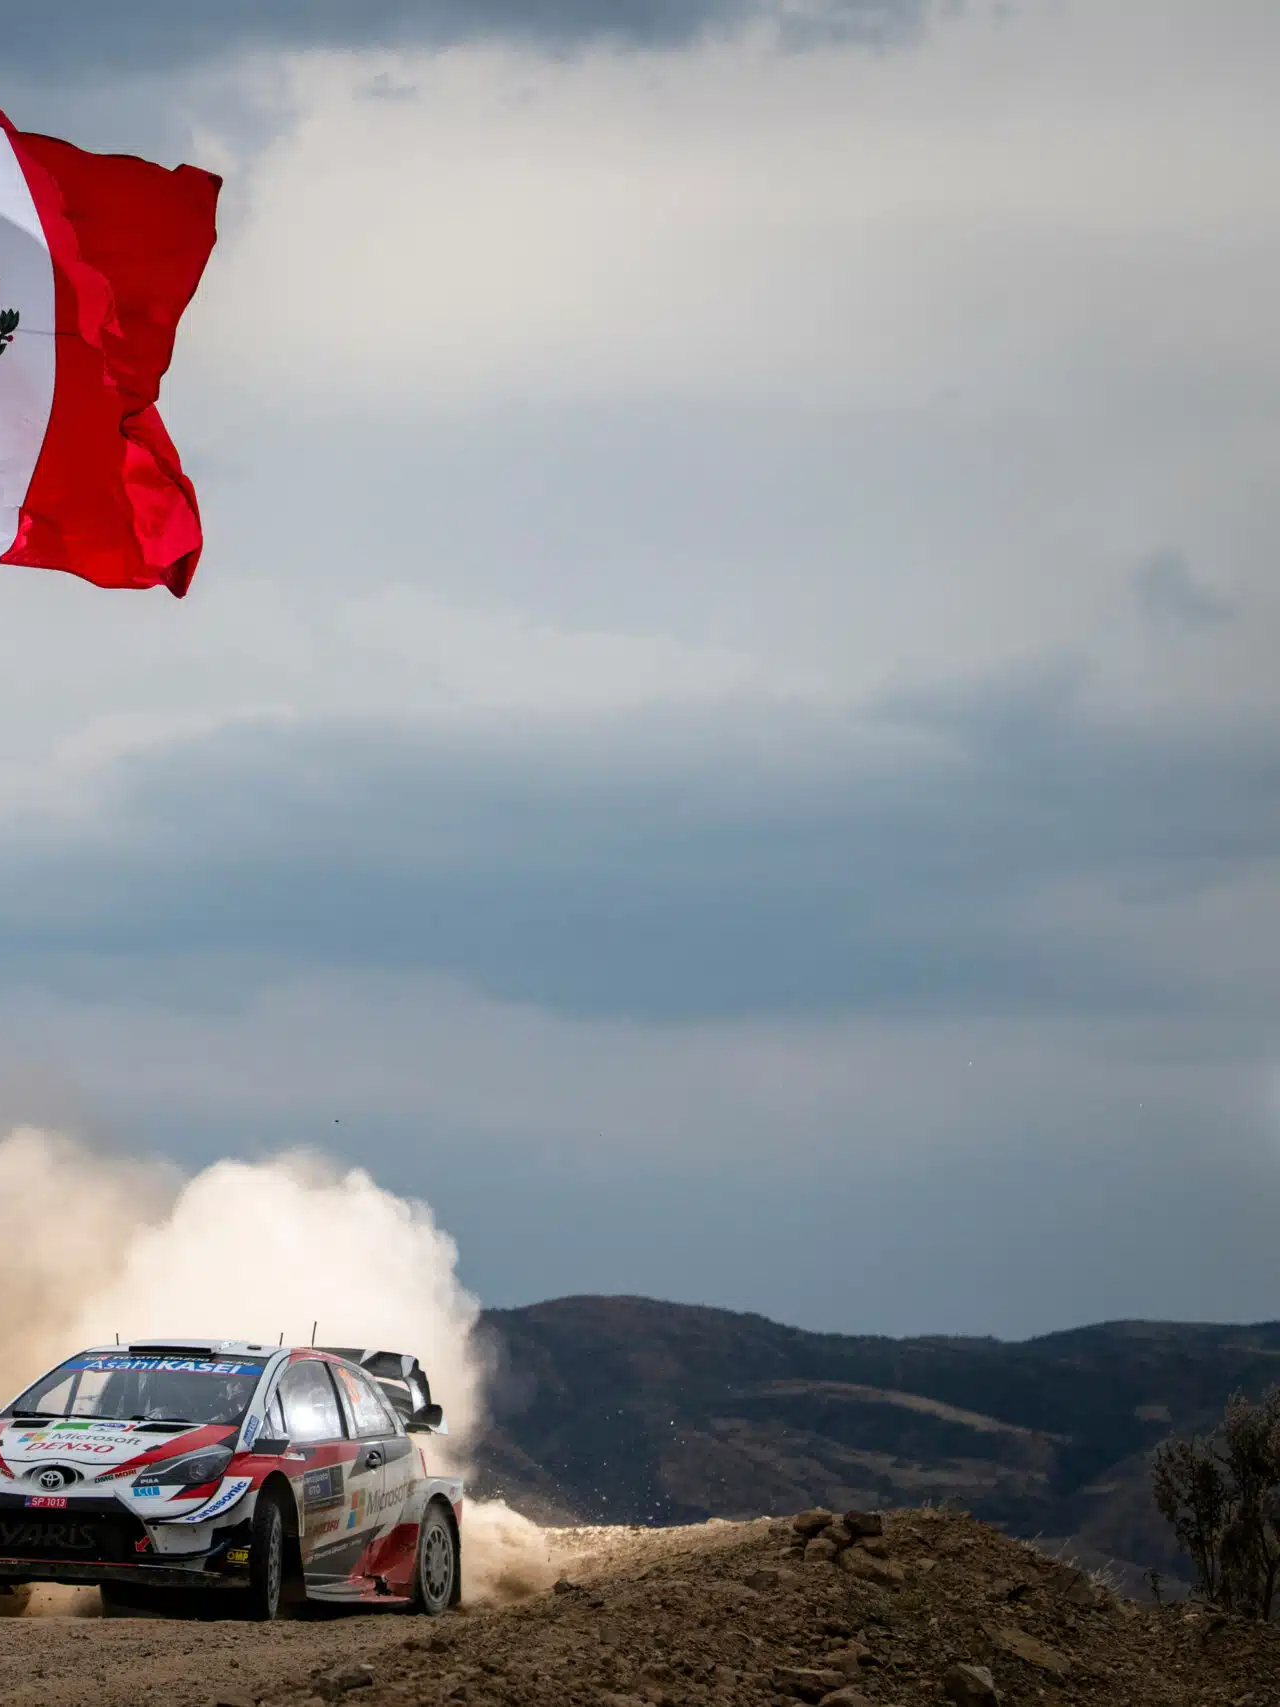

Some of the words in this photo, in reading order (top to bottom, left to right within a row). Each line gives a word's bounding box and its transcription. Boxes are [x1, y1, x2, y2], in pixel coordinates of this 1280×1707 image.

[52, 1432, 143, 1446] Microsoft
[25, 1442, 115, 1454] DENSO
[94, 1474, 114, 1484] DMG
[115, 1469, 138, 1480] MORI
[31, 1497, 44, 1506] SP
[47, 1498, 66, 1507] 1013
[185, 1480, 248, 1522] Panasonic
[226, 1552, 249, 1561] OMP
